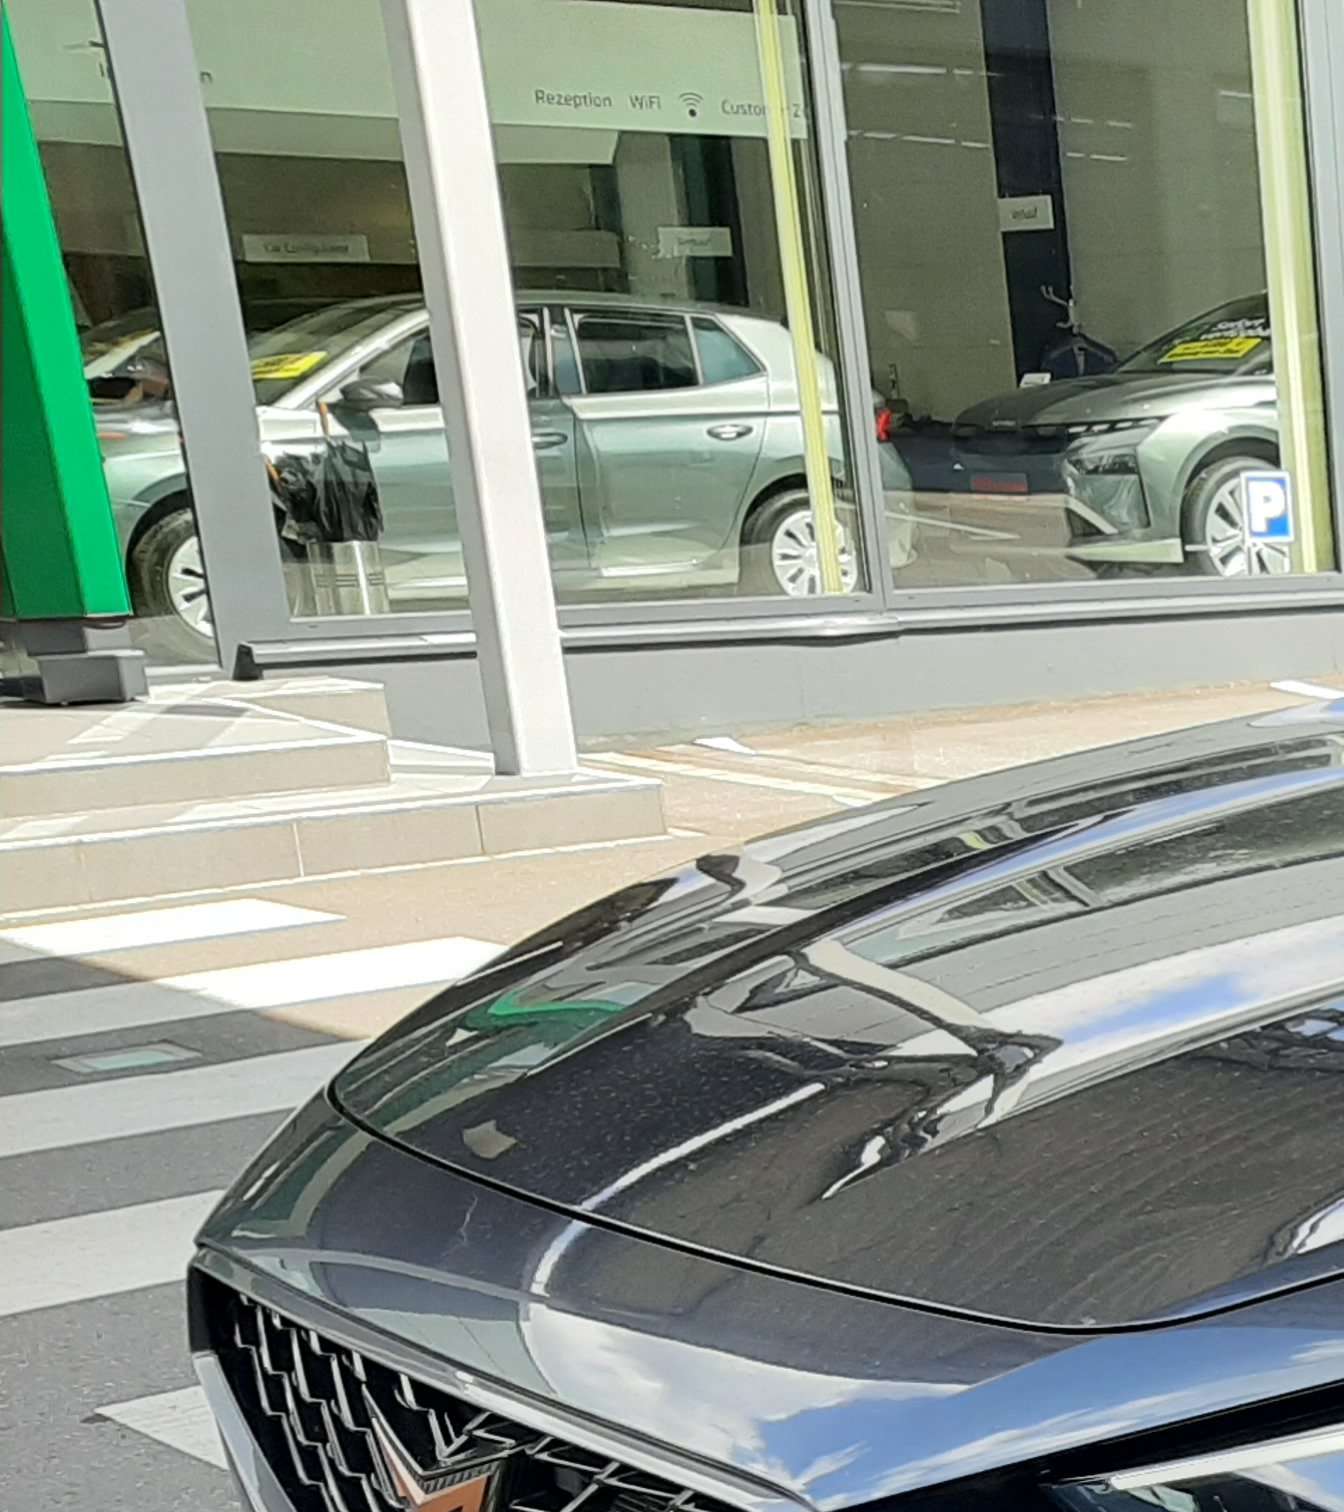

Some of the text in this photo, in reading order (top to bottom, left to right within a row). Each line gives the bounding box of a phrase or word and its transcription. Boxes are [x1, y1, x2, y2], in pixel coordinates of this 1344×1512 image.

[535, 89, 612, 109] Rezeption
[629, 95, 661, 111] WiFi
[1248, 480, 1286, 533] P
